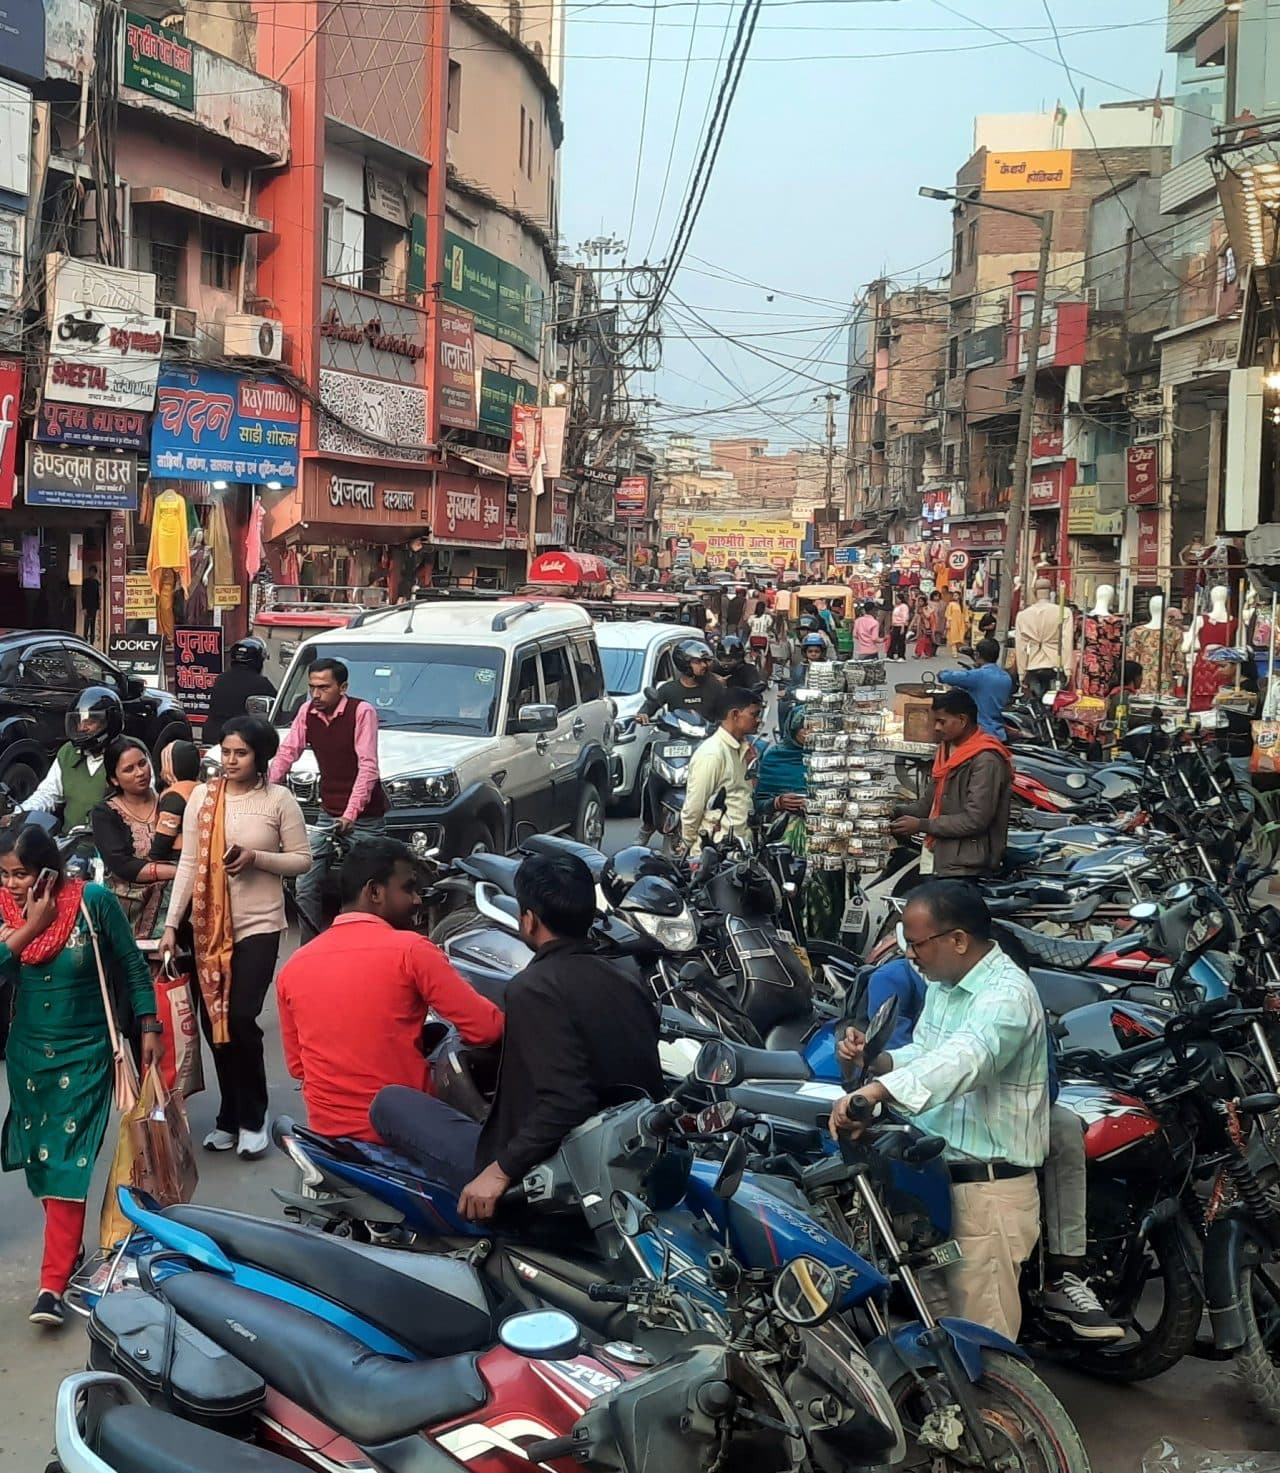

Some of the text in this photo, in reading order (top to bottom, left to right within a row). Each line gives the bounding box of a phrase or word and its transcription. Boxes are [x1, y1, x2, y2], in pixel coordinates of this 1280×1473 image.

[52, 361, 109, 391] SHEETAL
[158, 373, 234, 443] चंदन
[241, 387, 296, 415] Raymond
[95, 458, 131, 485] हाउस
[330, 474, 376, 509] अजन्ता
[952, 554, 965, 564] 20
[110, 640, 159, 651] JOCKEY
[176, 630, 220, 663] पूनम
